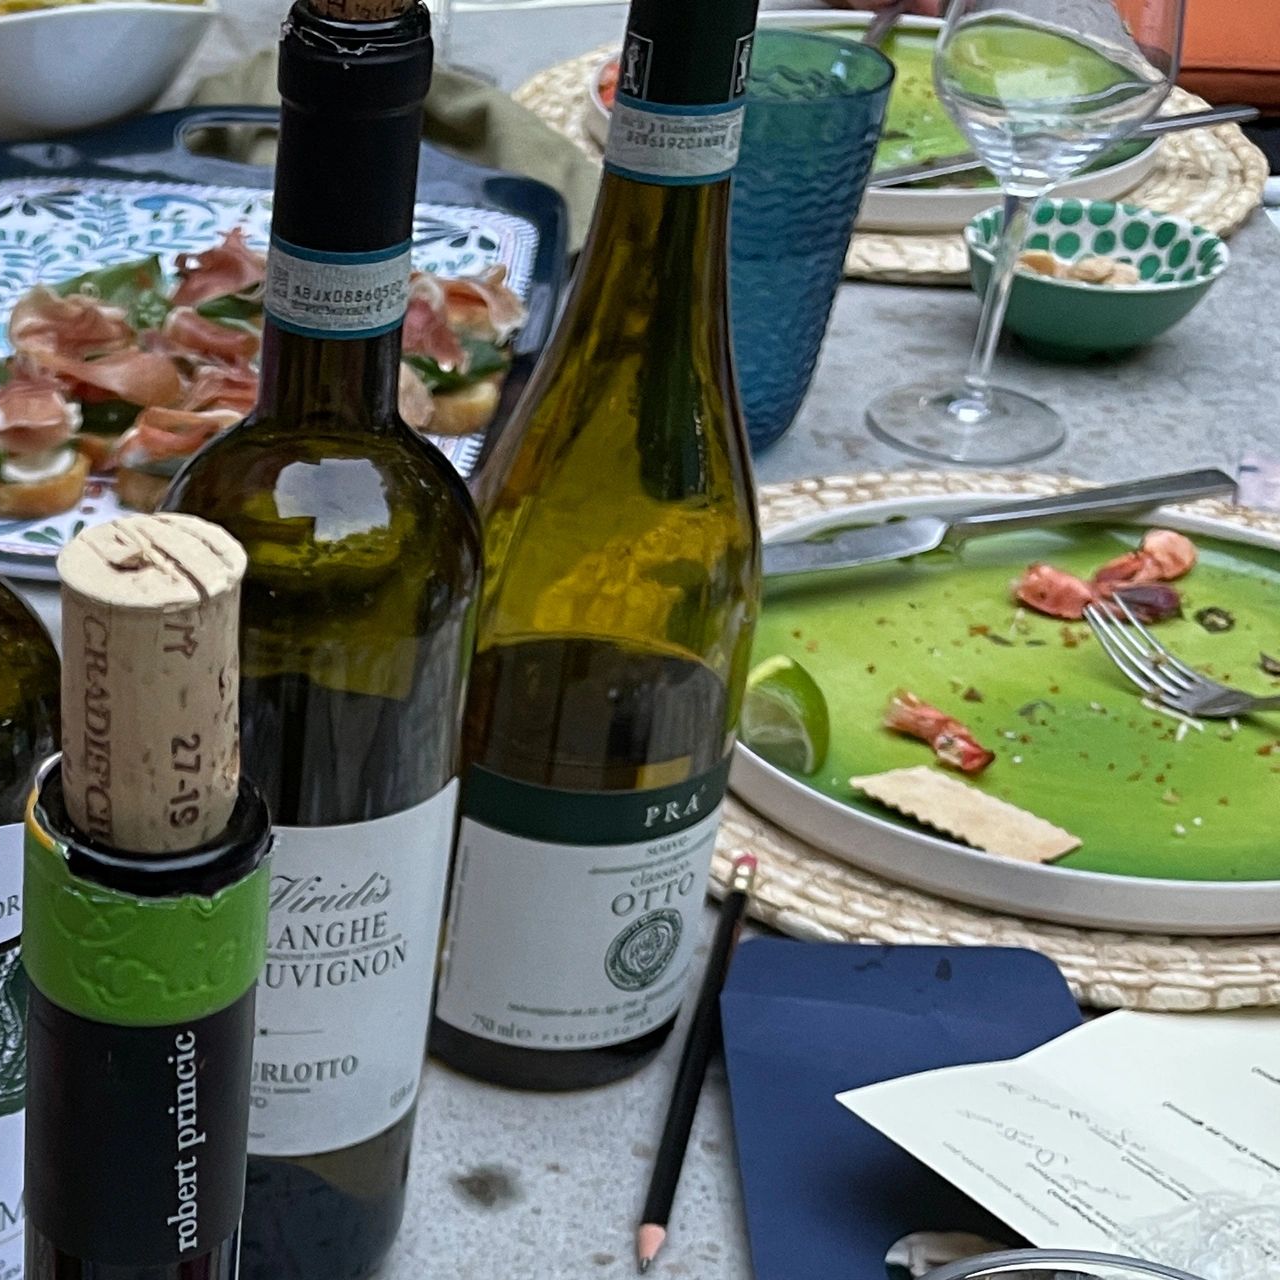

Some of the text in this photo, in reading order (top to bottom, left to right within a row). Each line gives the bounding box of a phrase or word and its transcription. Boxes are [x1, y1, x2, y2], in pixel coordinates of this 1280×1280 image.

[268, 870, 393, 914] Viridis
[611, 871, 695, 917] OTTO
[266, 910, 389, 951] ANGHE
[256, 940, 409, 990] UVIGNON
[167, 1030, 206, 1253] robert princic
